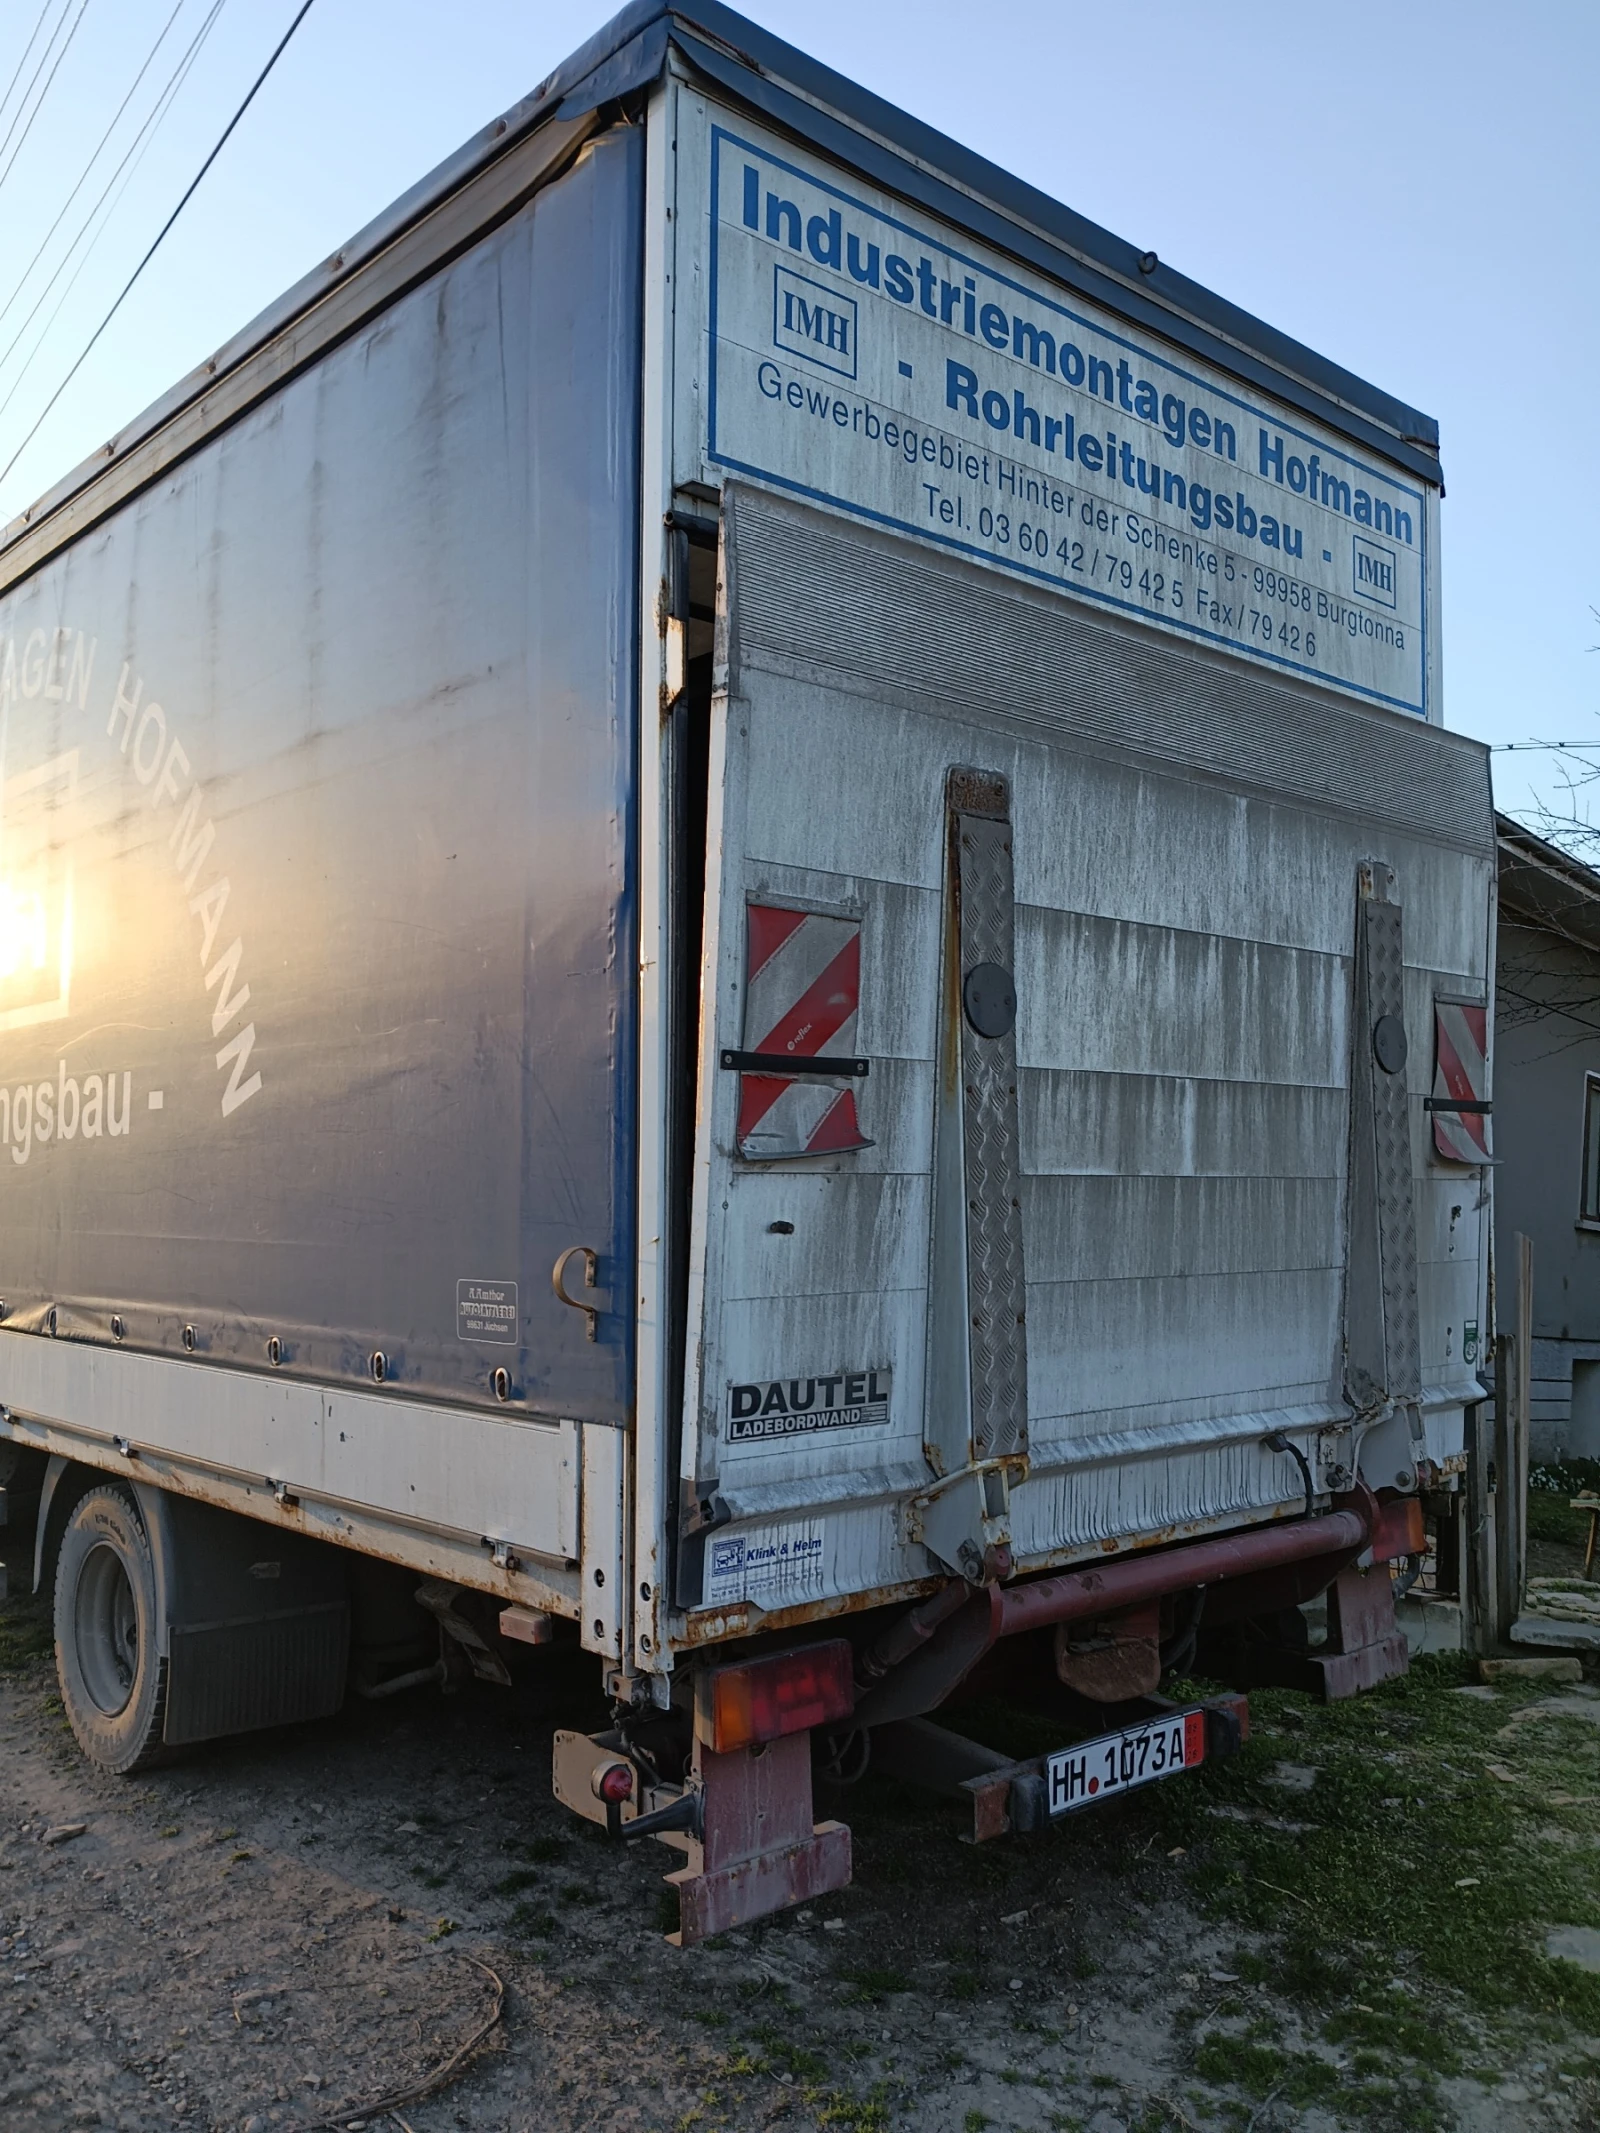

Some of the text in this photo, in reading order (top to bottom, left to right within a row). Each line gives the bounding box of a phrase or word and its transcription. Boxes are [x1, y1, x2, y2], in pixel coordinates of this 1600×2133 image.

[743, 164, 1413, 544] Industriemontagen Hofmann
[782, 290, 850, 356] IMH
[946, 358, 1303, 560] Rohrleitungsbau
[758, 361, 989, 485] Gewerbegebiet
[998, 459, 1074, 518] Hinter
[1081, 499, 1119, 535] der
[1126, 514, 1218, 575] Schenke
[1224, 555, 1235, 582] 5
[1253, 566, 1311, 612] 99958
[1317, 591, 1405, 650] Burgtonna
[923, 483, 970, 531] Tel.
[979, 507, 1010, 544] 03
[1019, 522, 1048, 558] 60
[1056, 537, 1084, 572] 42
[1105, 554, 1132, 589] 79
[1197, 588, 1233, 627] Fax
[1249, 609, 1273, 640] 79
[1357, 552, 1393, 593] IMH
[107, 661, 263, 1118] HOFMANN
[731, 1373, 888, 1419] DAUTEL
[732, 1408, 861, 1438] LADEBORDWAND
[746, 1545, 777, 1562] Klink
[780, 1543, 789, 1555] &
[1052, 1727, 1184, 1806] HH 1073A
